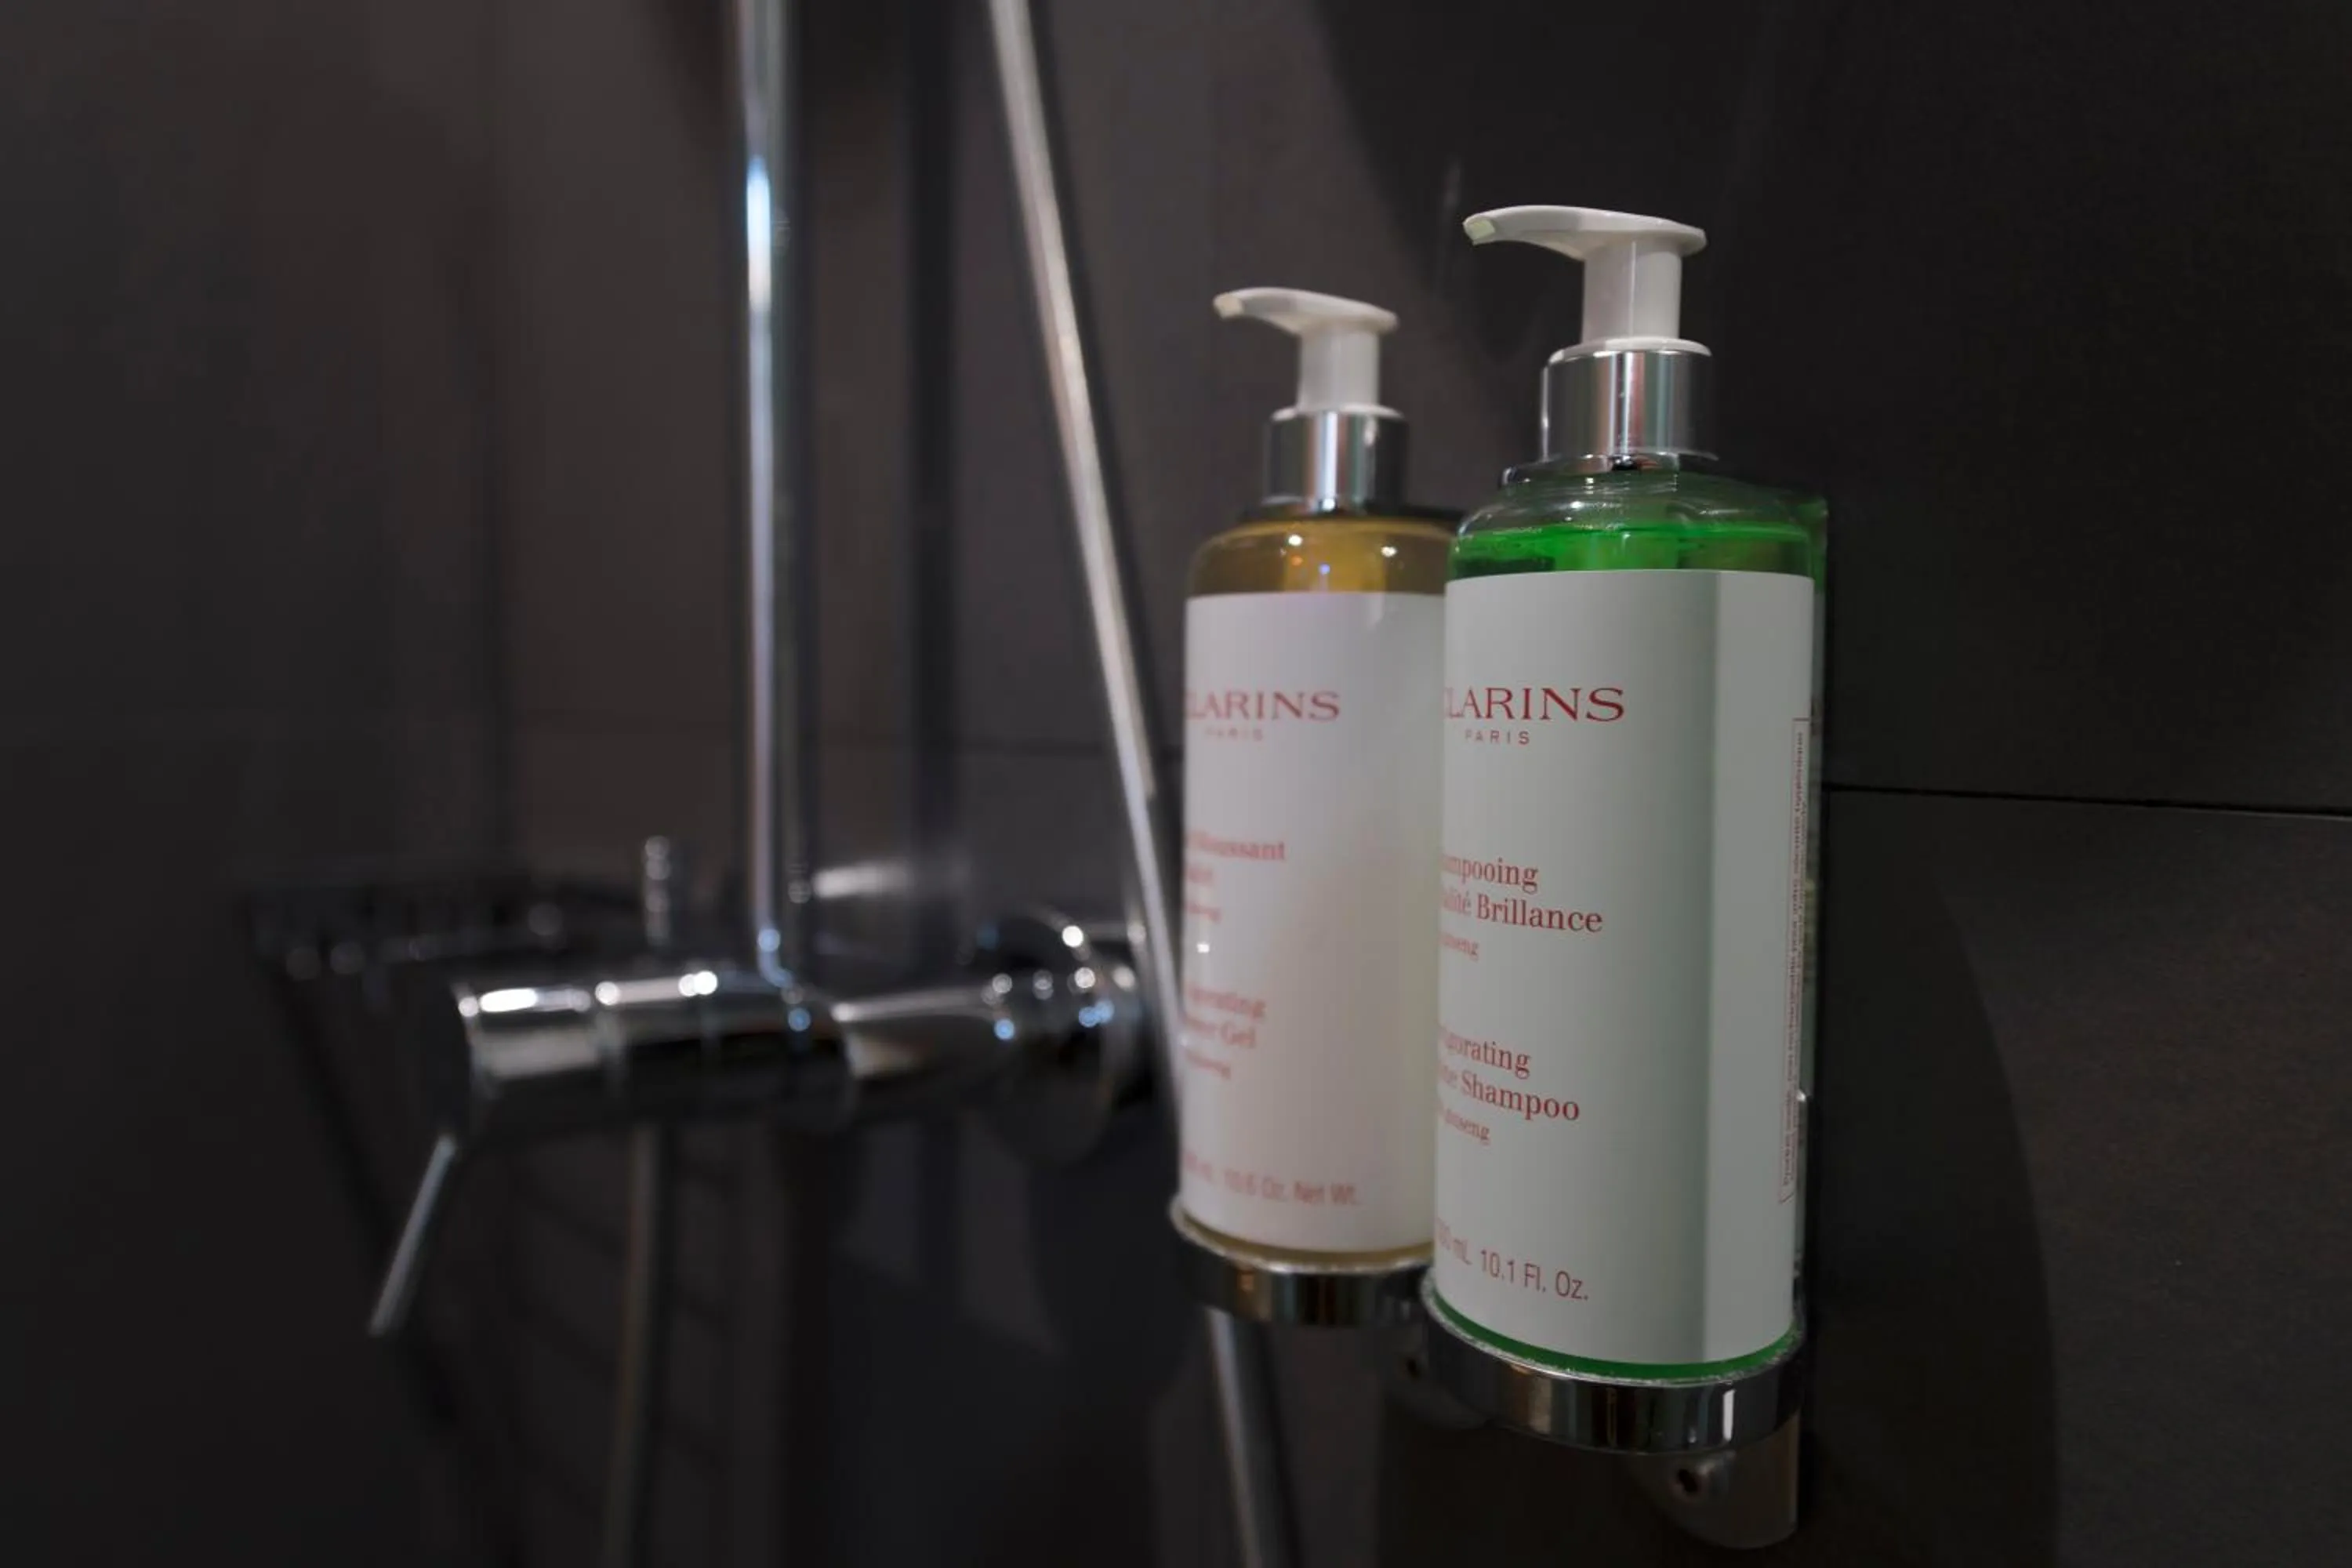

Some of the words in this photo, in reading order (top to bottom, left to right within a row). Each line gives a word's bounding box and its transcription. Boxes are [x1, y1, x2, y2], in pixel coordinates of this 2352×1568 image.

[1185, 689, 1341, 720] LARINS
[1443, 686, 1625, 722] LARINS
[1465, 730, 1530, 745] PARIS
[1476, 892, 1602, 933] Brillance
[1461, 1069, 1580, 1121] Shampoo
[1481, 1249, 1514, 1284] 10.1
[1524, 1262, 1547, 1293] Fl.
[1555, 1270, 1589, 1301] Oz.
